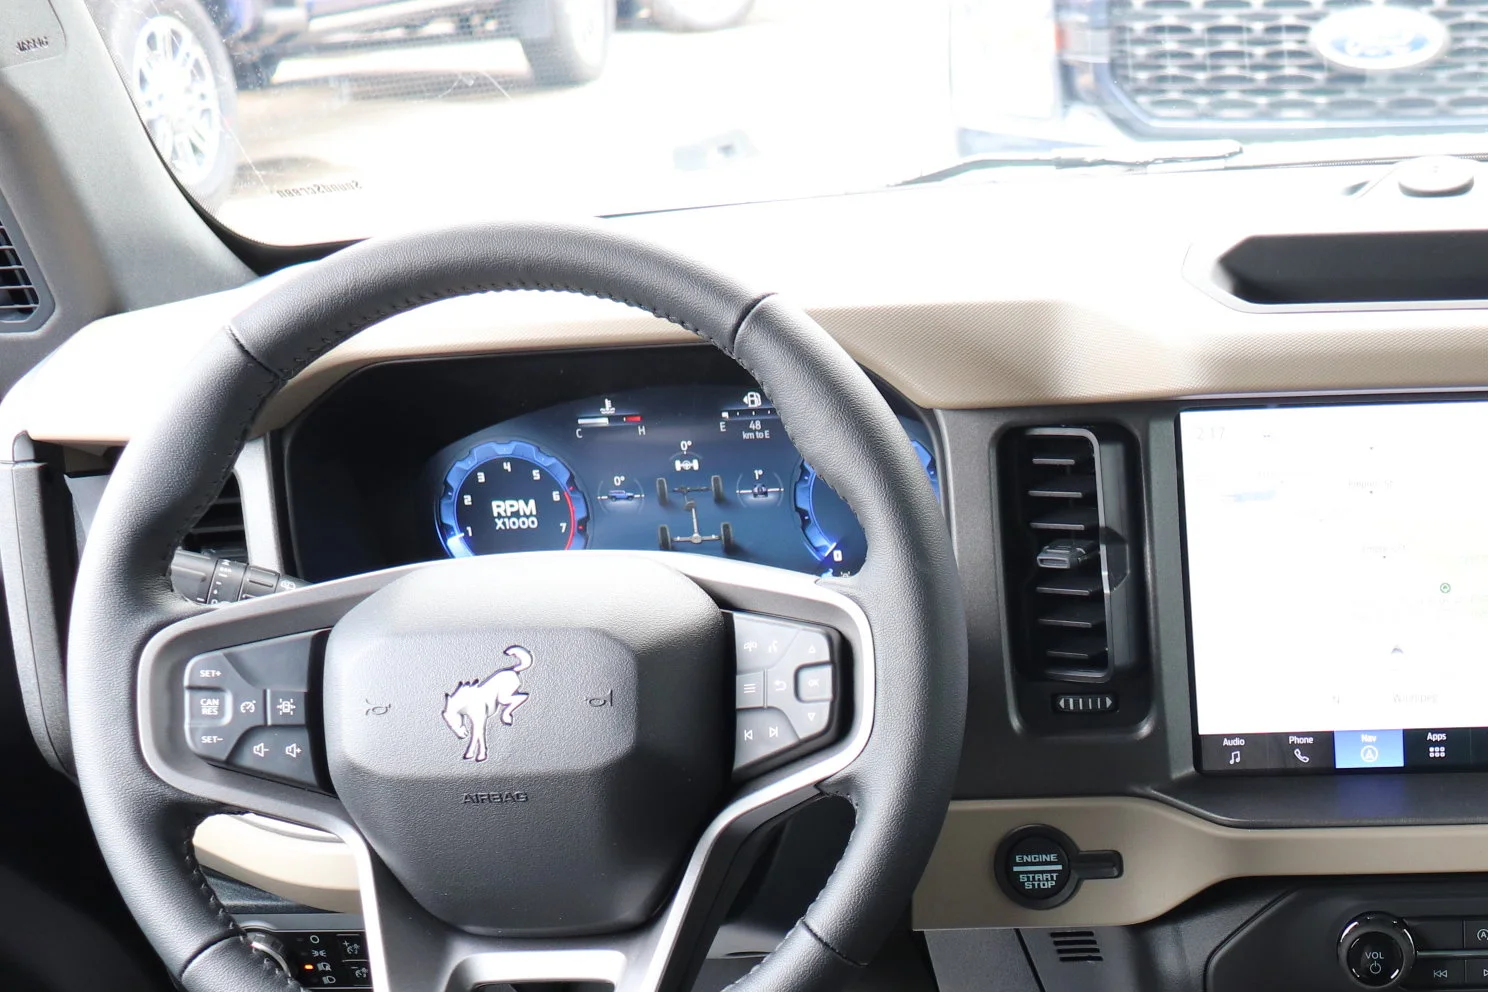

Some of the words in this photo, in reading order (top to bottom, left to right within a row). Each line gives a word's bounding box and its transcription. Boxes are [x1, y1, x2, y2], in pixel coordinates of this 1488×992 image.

[638, 426, 646, 436] H
[719, 421, 727, 432] E
[748, 420, 762, 431] 48
[576, 428, 583, 439] C
[742, 431, 755, 440] km
[755, 430, 764, 439] to
[764, 430, 770, 439] E
[503, 461, 512, 473] 4
[477, 471, 486, 483] 3
[532, 469, 541, 481] 5
[463, 494, 472, 506] 2
[552, 490, 561, 502] 6
[491, 499, 537, 517] RPM
[494, 516, 538, 531] X1000
[560, 522, 567, 533] 7
[466, 526, 473, 537] 1
[199, 669, 222, 678] SET+
[807, 679, 820, 688] OK
[200, 698, 220, 707] CAN
[201, 707, 219, 716] RES
[1222, 736, 1246, 748] Audio
[1288, 734, 1314, 746] Phone
[1360, 733, 1377, 744] Nav
[1426, 731, 1447, 743] Apps
[460, 791, 529, 804] AIRBAG
[1015, 853, 1059, 863] ENGINE
[1019, 872, 1059, 883] START
[1024, 880, 1056, 889] STOP
[1365, 951, 1385, 960] VOL
